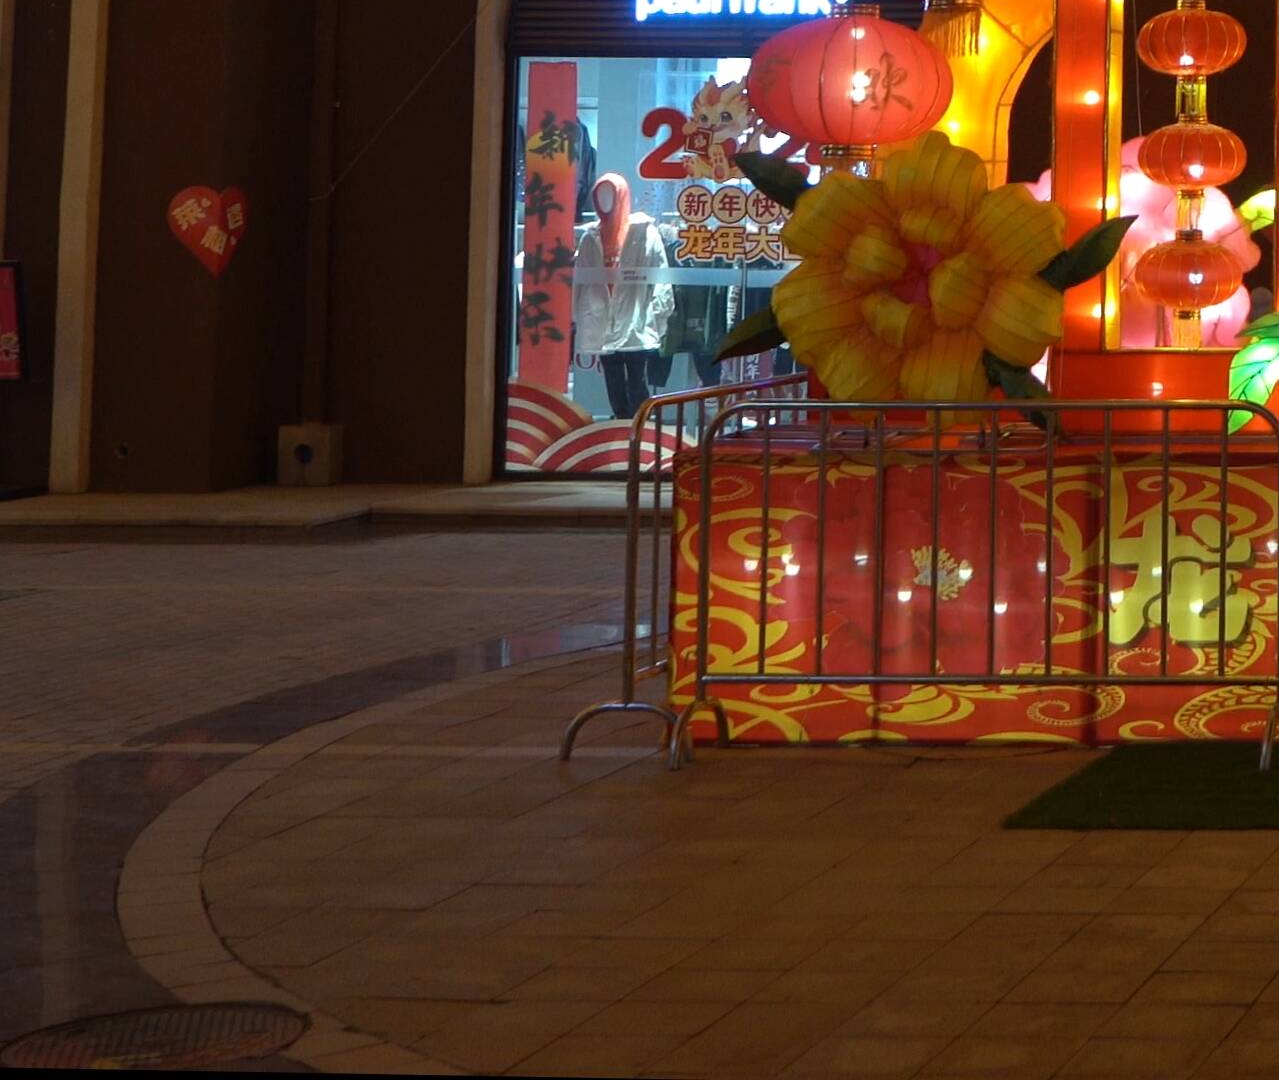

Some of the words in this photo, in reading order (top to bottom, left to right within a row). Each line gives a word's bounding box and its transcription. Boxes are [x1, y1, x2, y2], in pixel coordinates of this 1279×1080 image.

[684, 192, 792, 218] 新年快
[526, 110, 581, 346] 新年快乐
[677, 225, 803, 262] 龙年大
